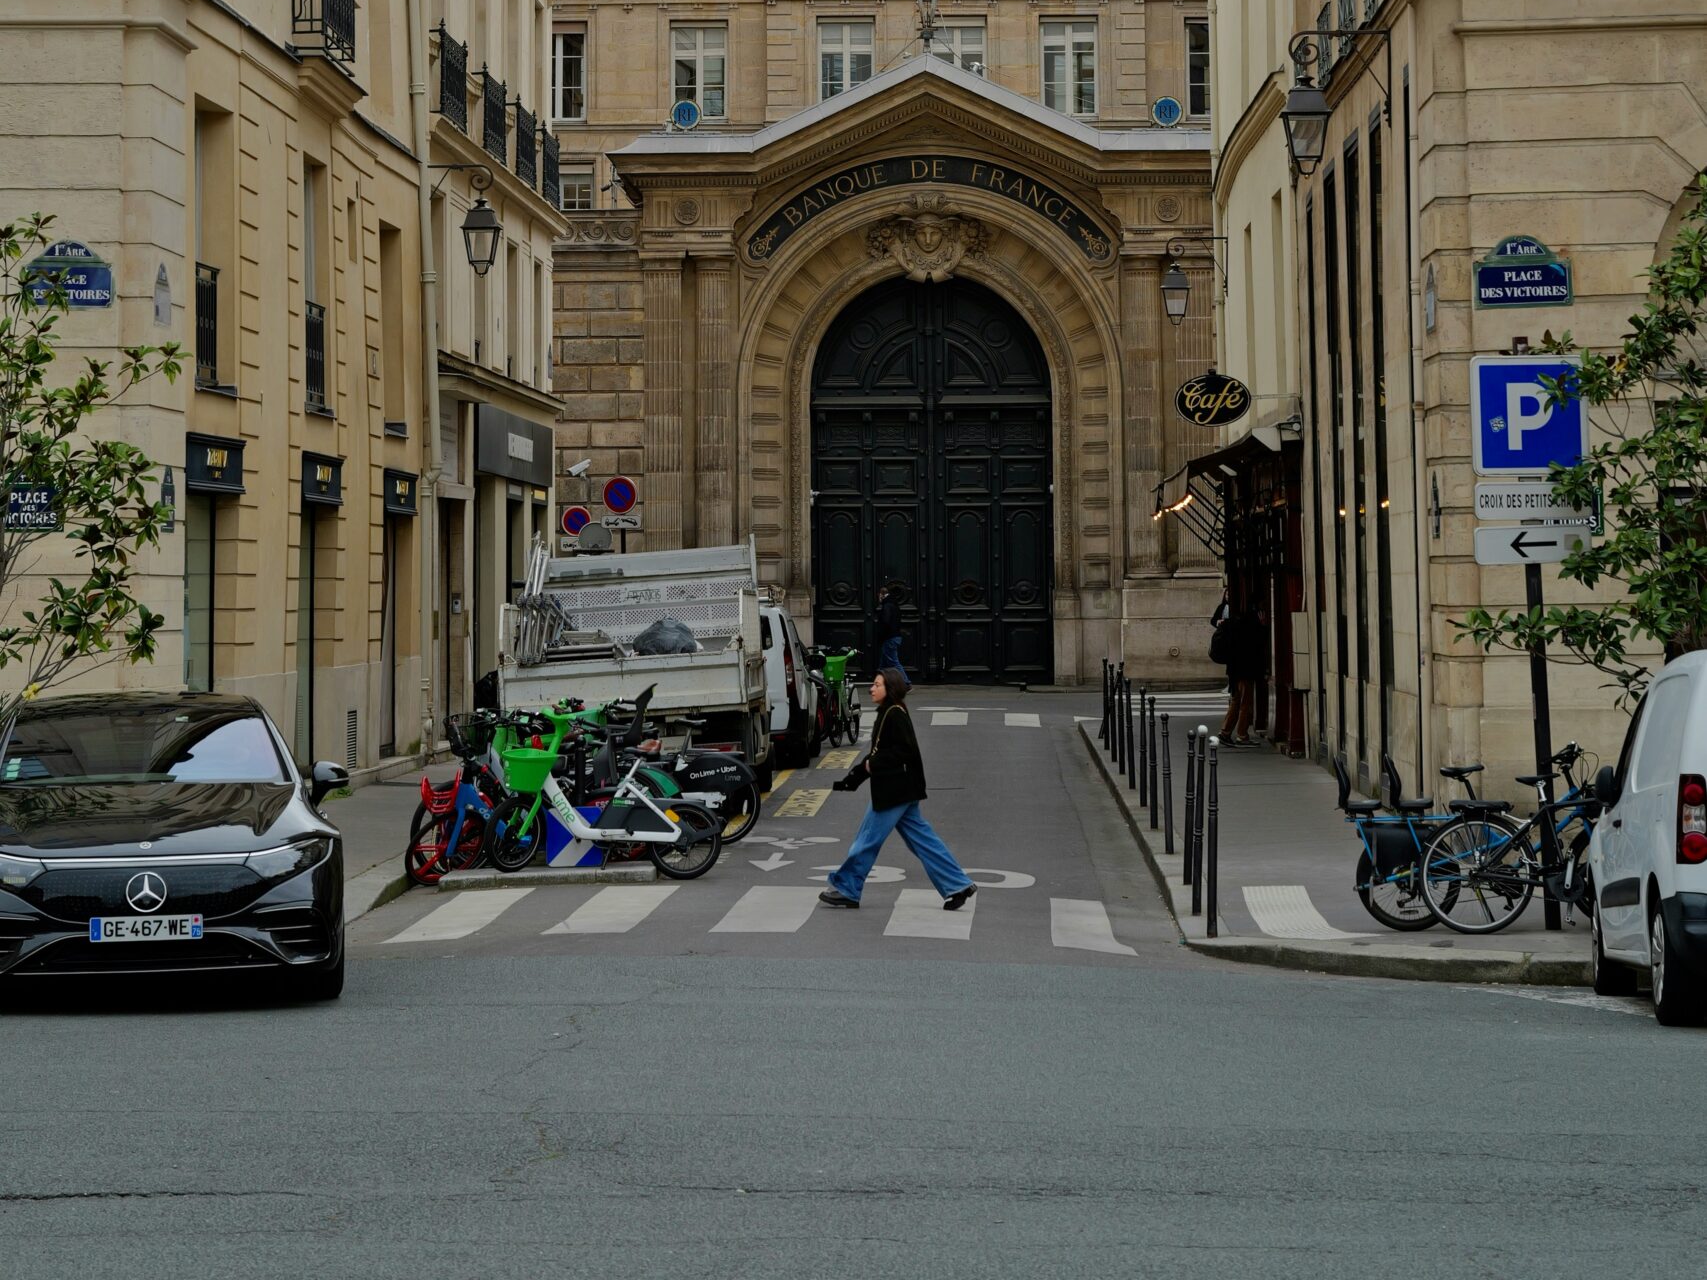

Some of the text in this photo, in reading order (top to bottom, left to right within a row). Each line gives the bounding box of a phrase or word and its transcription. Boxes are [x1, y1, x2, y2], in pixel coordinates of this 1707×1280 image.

[782, 159, 1078, 229] BANQUE DE FRANCE
[1504, 270, 1542, 282] PLACE
[1480, 285, 1568, 299] DES VICTOIRES
[1182, 380, 1245, 425] Café
[1506, 382, 1554, 451] P
[10, 491, 48, 504] PLACE
[1479, 494, 1504, 509] CROIX
[1506, 493, 1523, 509] DES
[1525, 493, 1553, 509] PETITS
[700, 768, 716, 778] Lime
[720, 765, 737, 774] Uber
[552, 792, 577, 824] Lime
[192, 927, 201, 936] 75
